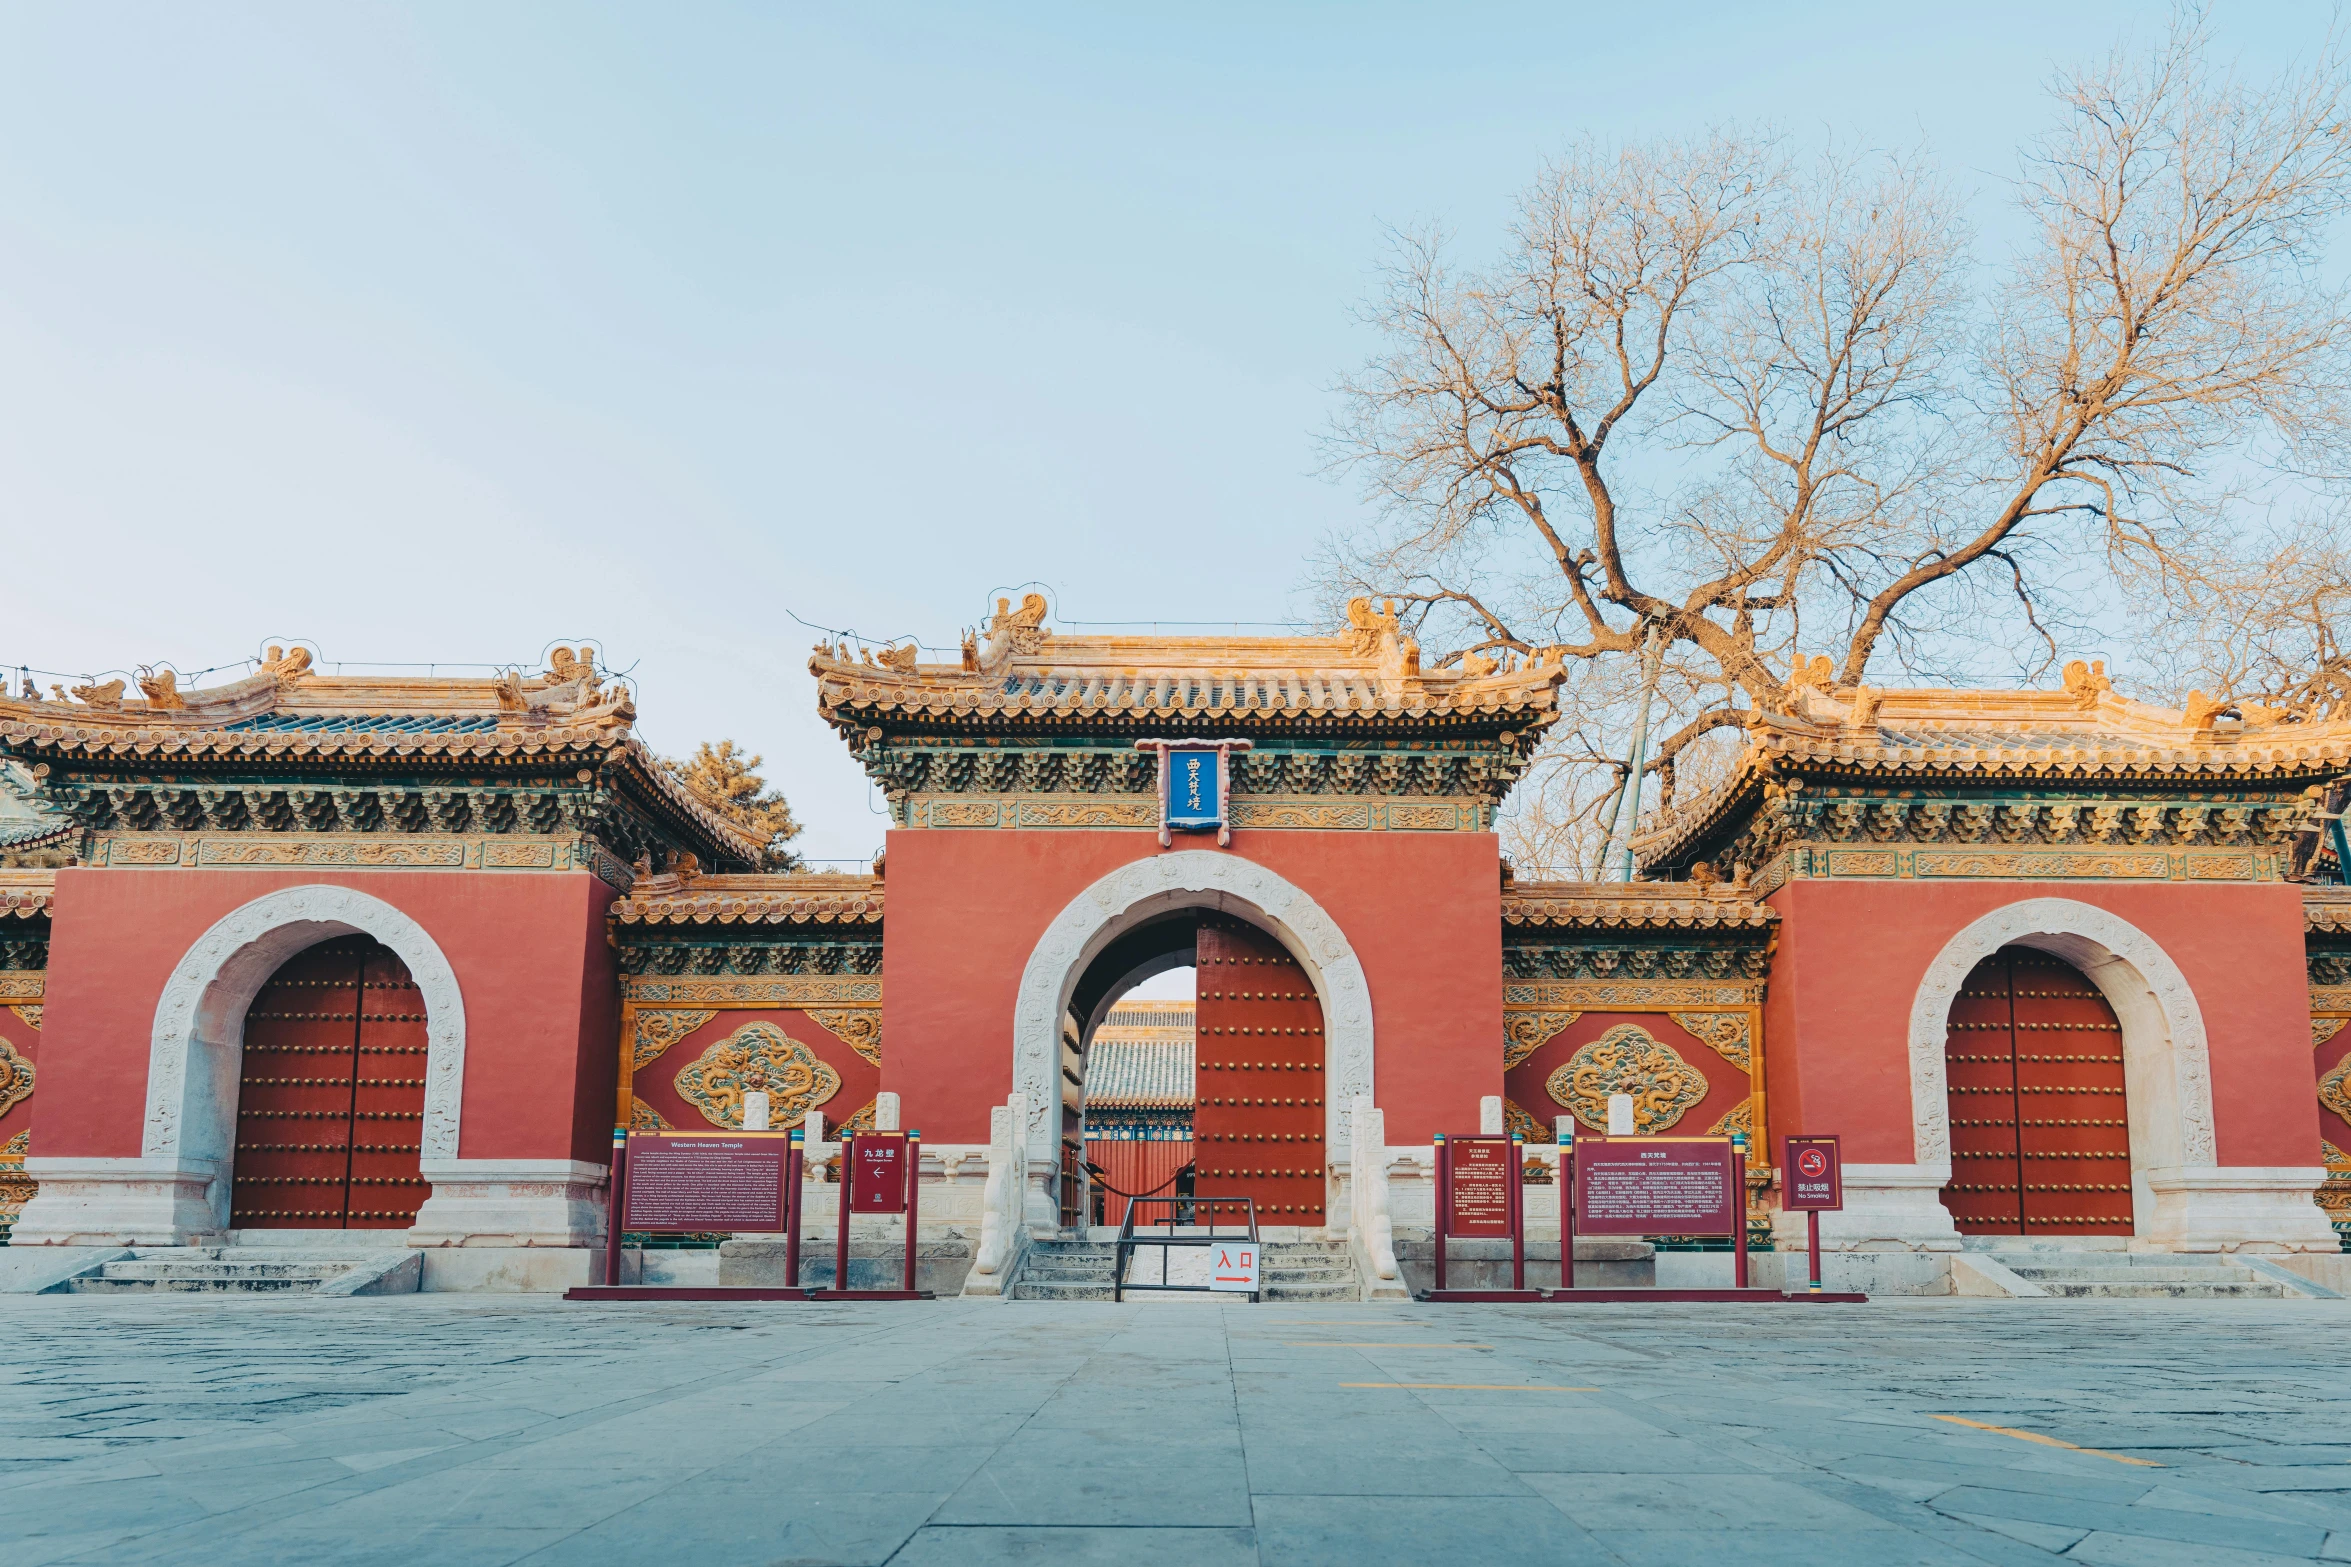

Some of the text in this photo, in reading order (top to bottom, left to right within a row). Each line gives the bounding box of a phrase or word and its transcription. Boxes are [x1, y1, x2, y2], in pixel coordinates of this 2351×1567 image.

[1187, 758, 1202, 811] 西天梵境
[864, 1148, 895, 1158] 九龙壁
[1797, 1183, 1829, 1192] 禁止吸烟
[1217, 1249, 1252, 1269] 入口
